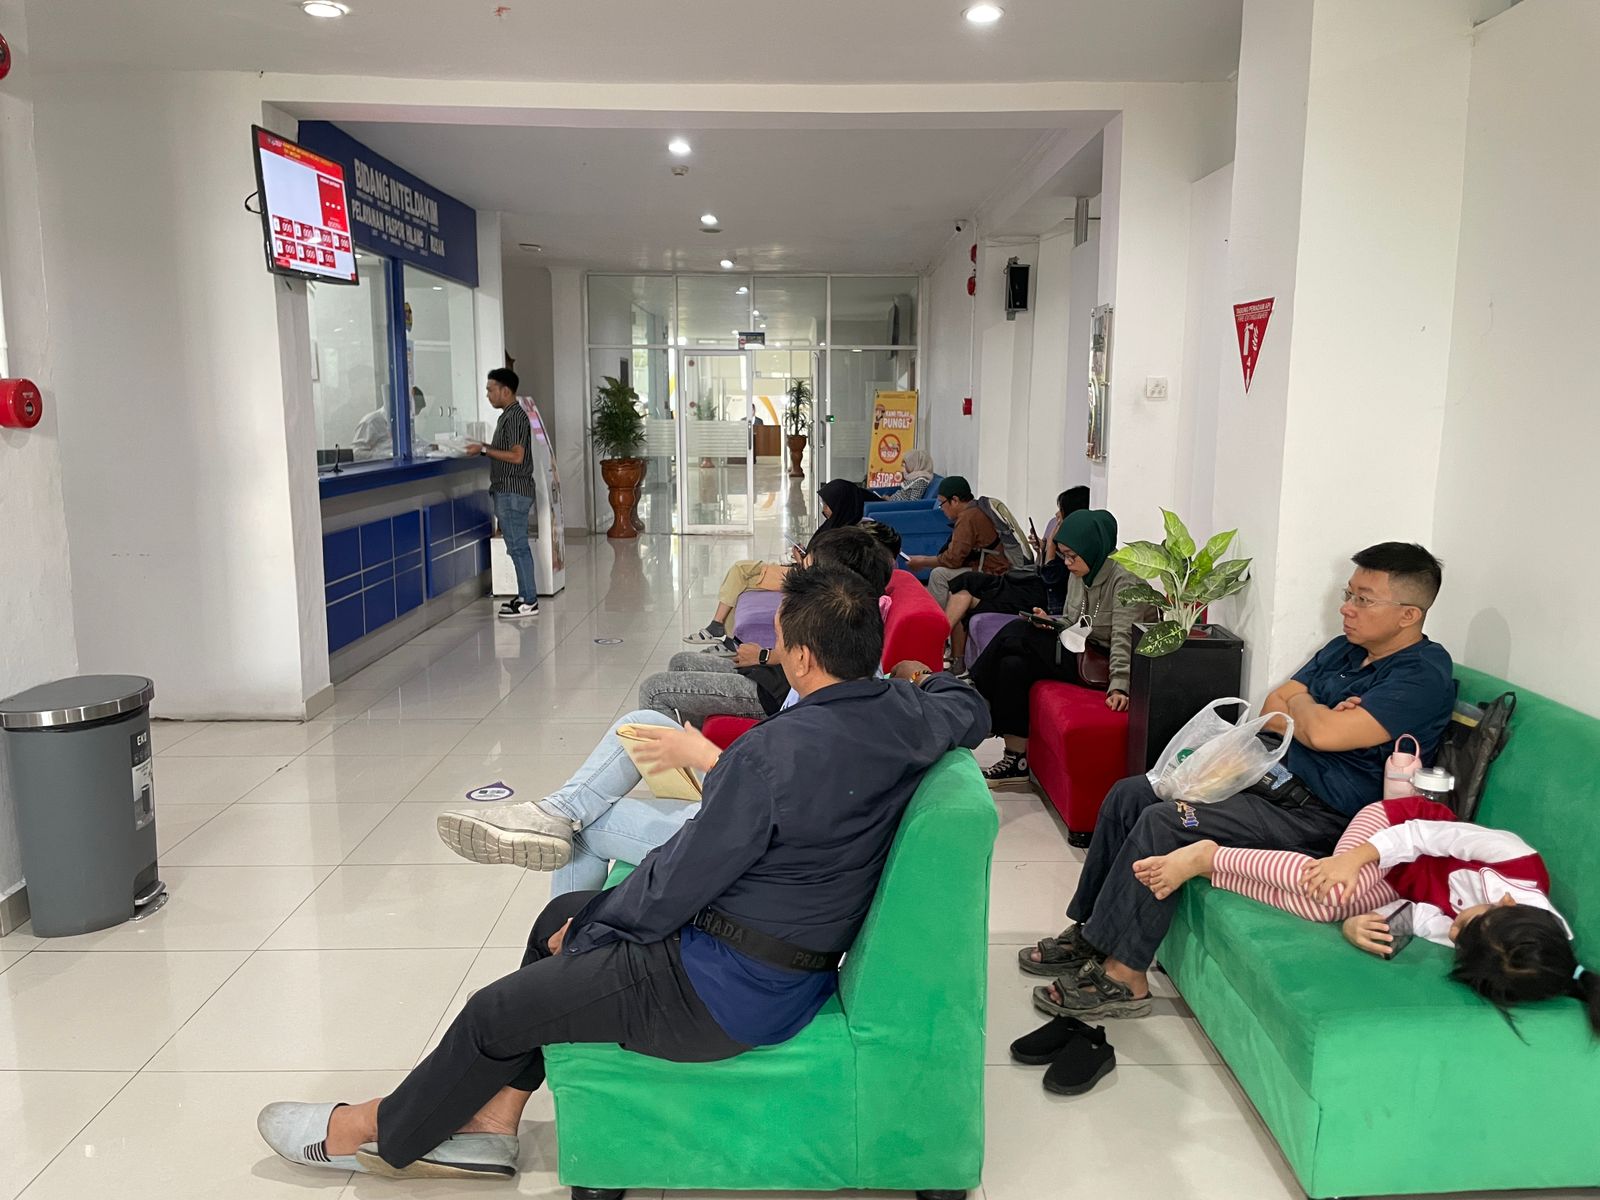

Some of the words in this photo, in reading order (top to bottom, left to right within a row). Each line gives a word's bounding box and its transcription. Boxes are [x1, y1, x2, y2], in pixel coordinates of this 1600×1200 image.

[354, 158, 389, 202] BIDANG
[390, 178, 438, 226] INTELDAKIM
[352, 199, 384, 232] PELAYANAN
[384, 215, 405, 240] PASPOR
[877, 473, 893, 482] STOP
[137, 732, 147, 746] EKO
[702, 912, 744, 944] RADA
